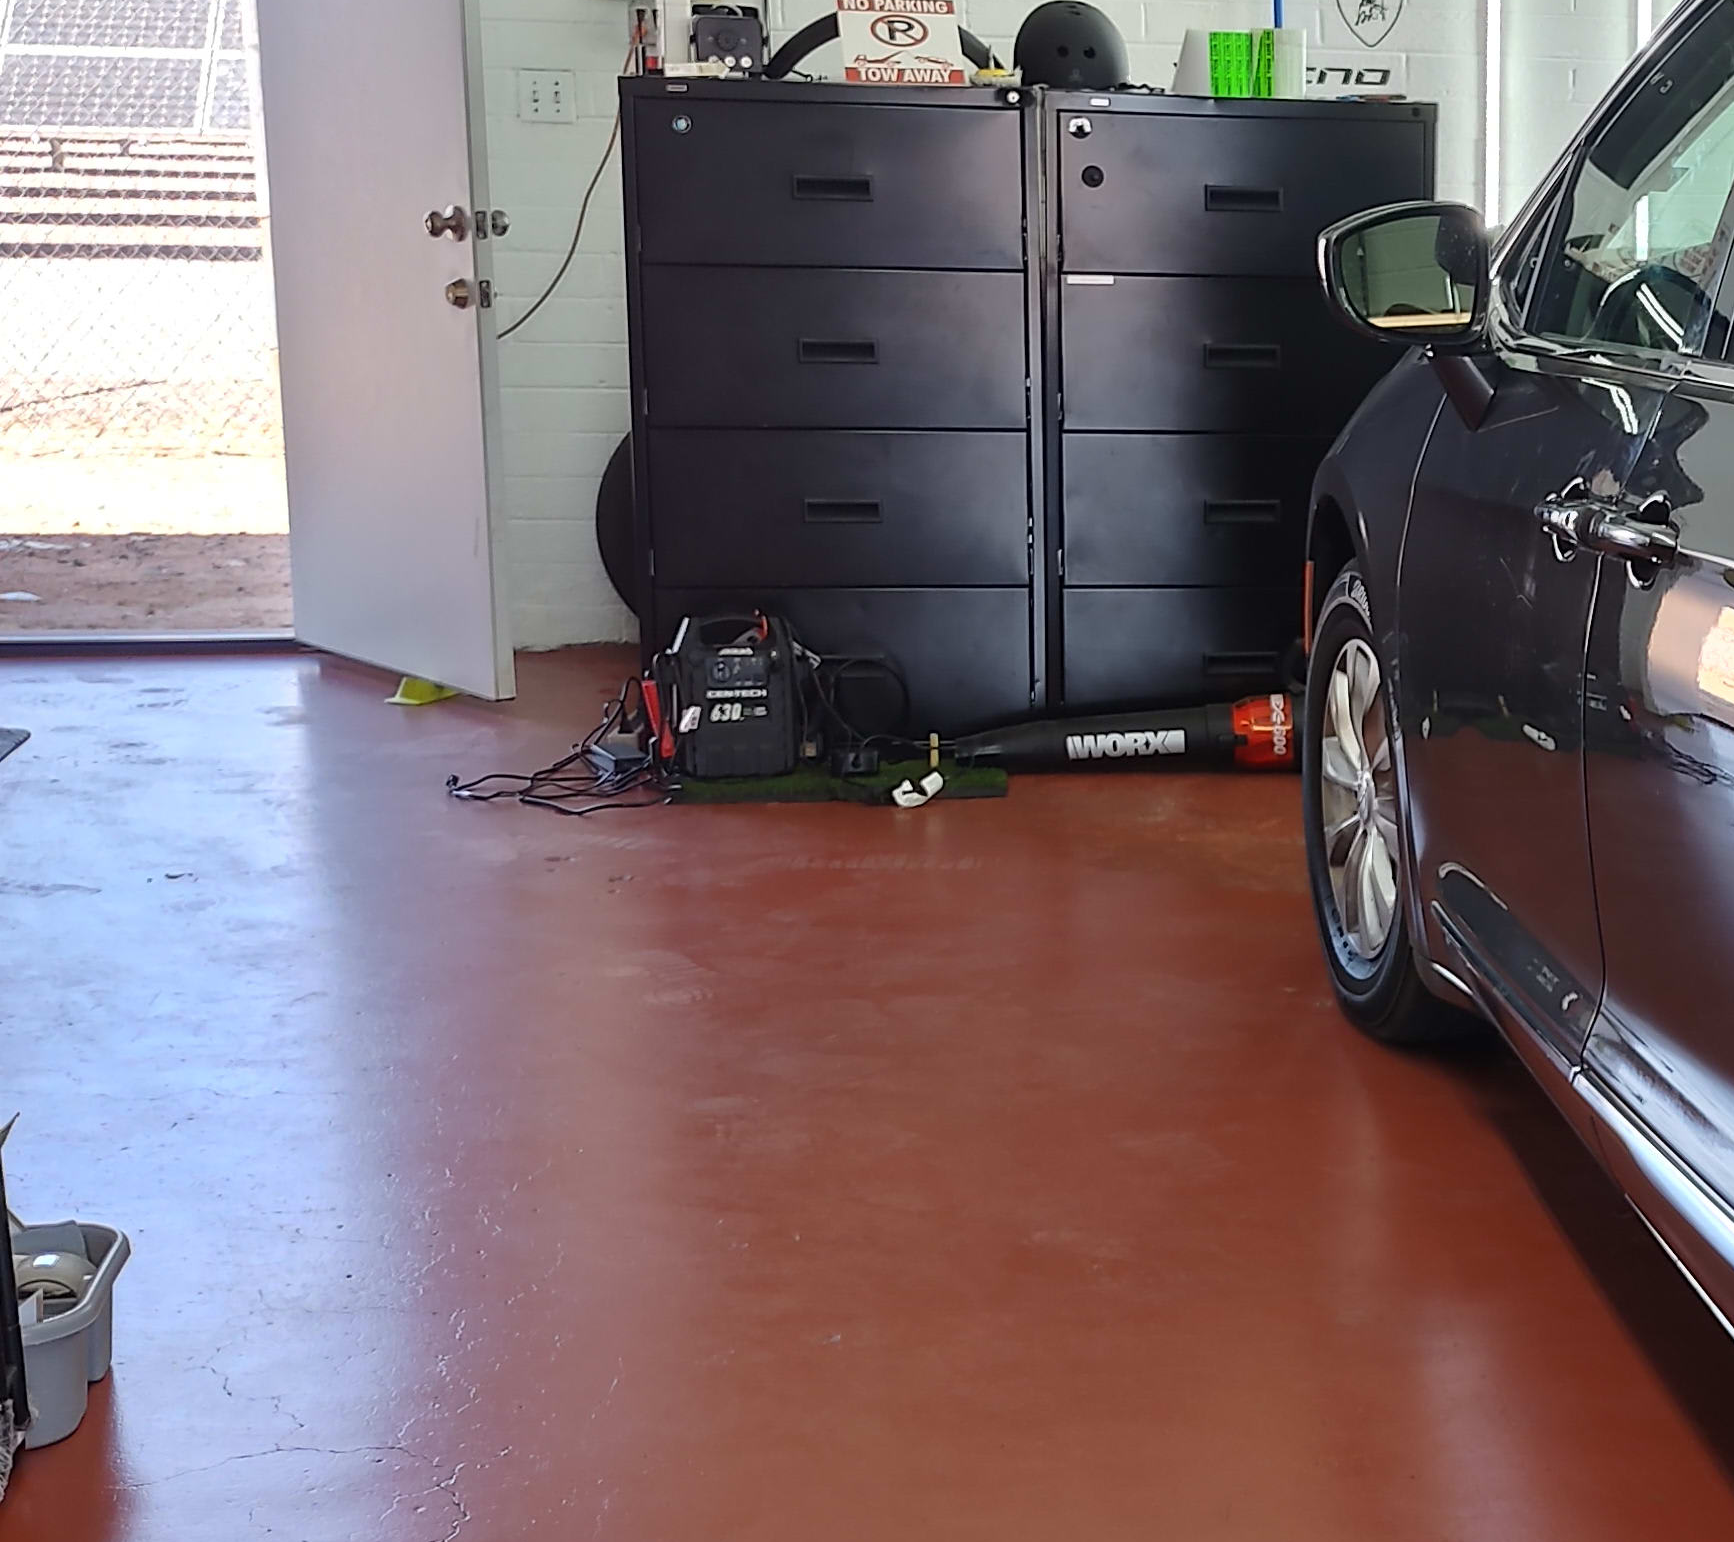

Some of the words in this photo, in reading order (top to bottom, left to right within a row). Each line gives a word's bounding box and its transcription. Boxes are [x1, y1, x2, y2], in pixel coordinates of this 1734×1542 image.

[858, 68, 899, 82] TOW
[903, 69, 951, 83] AWAY
[1070, 730, 1174, 758] WORX
